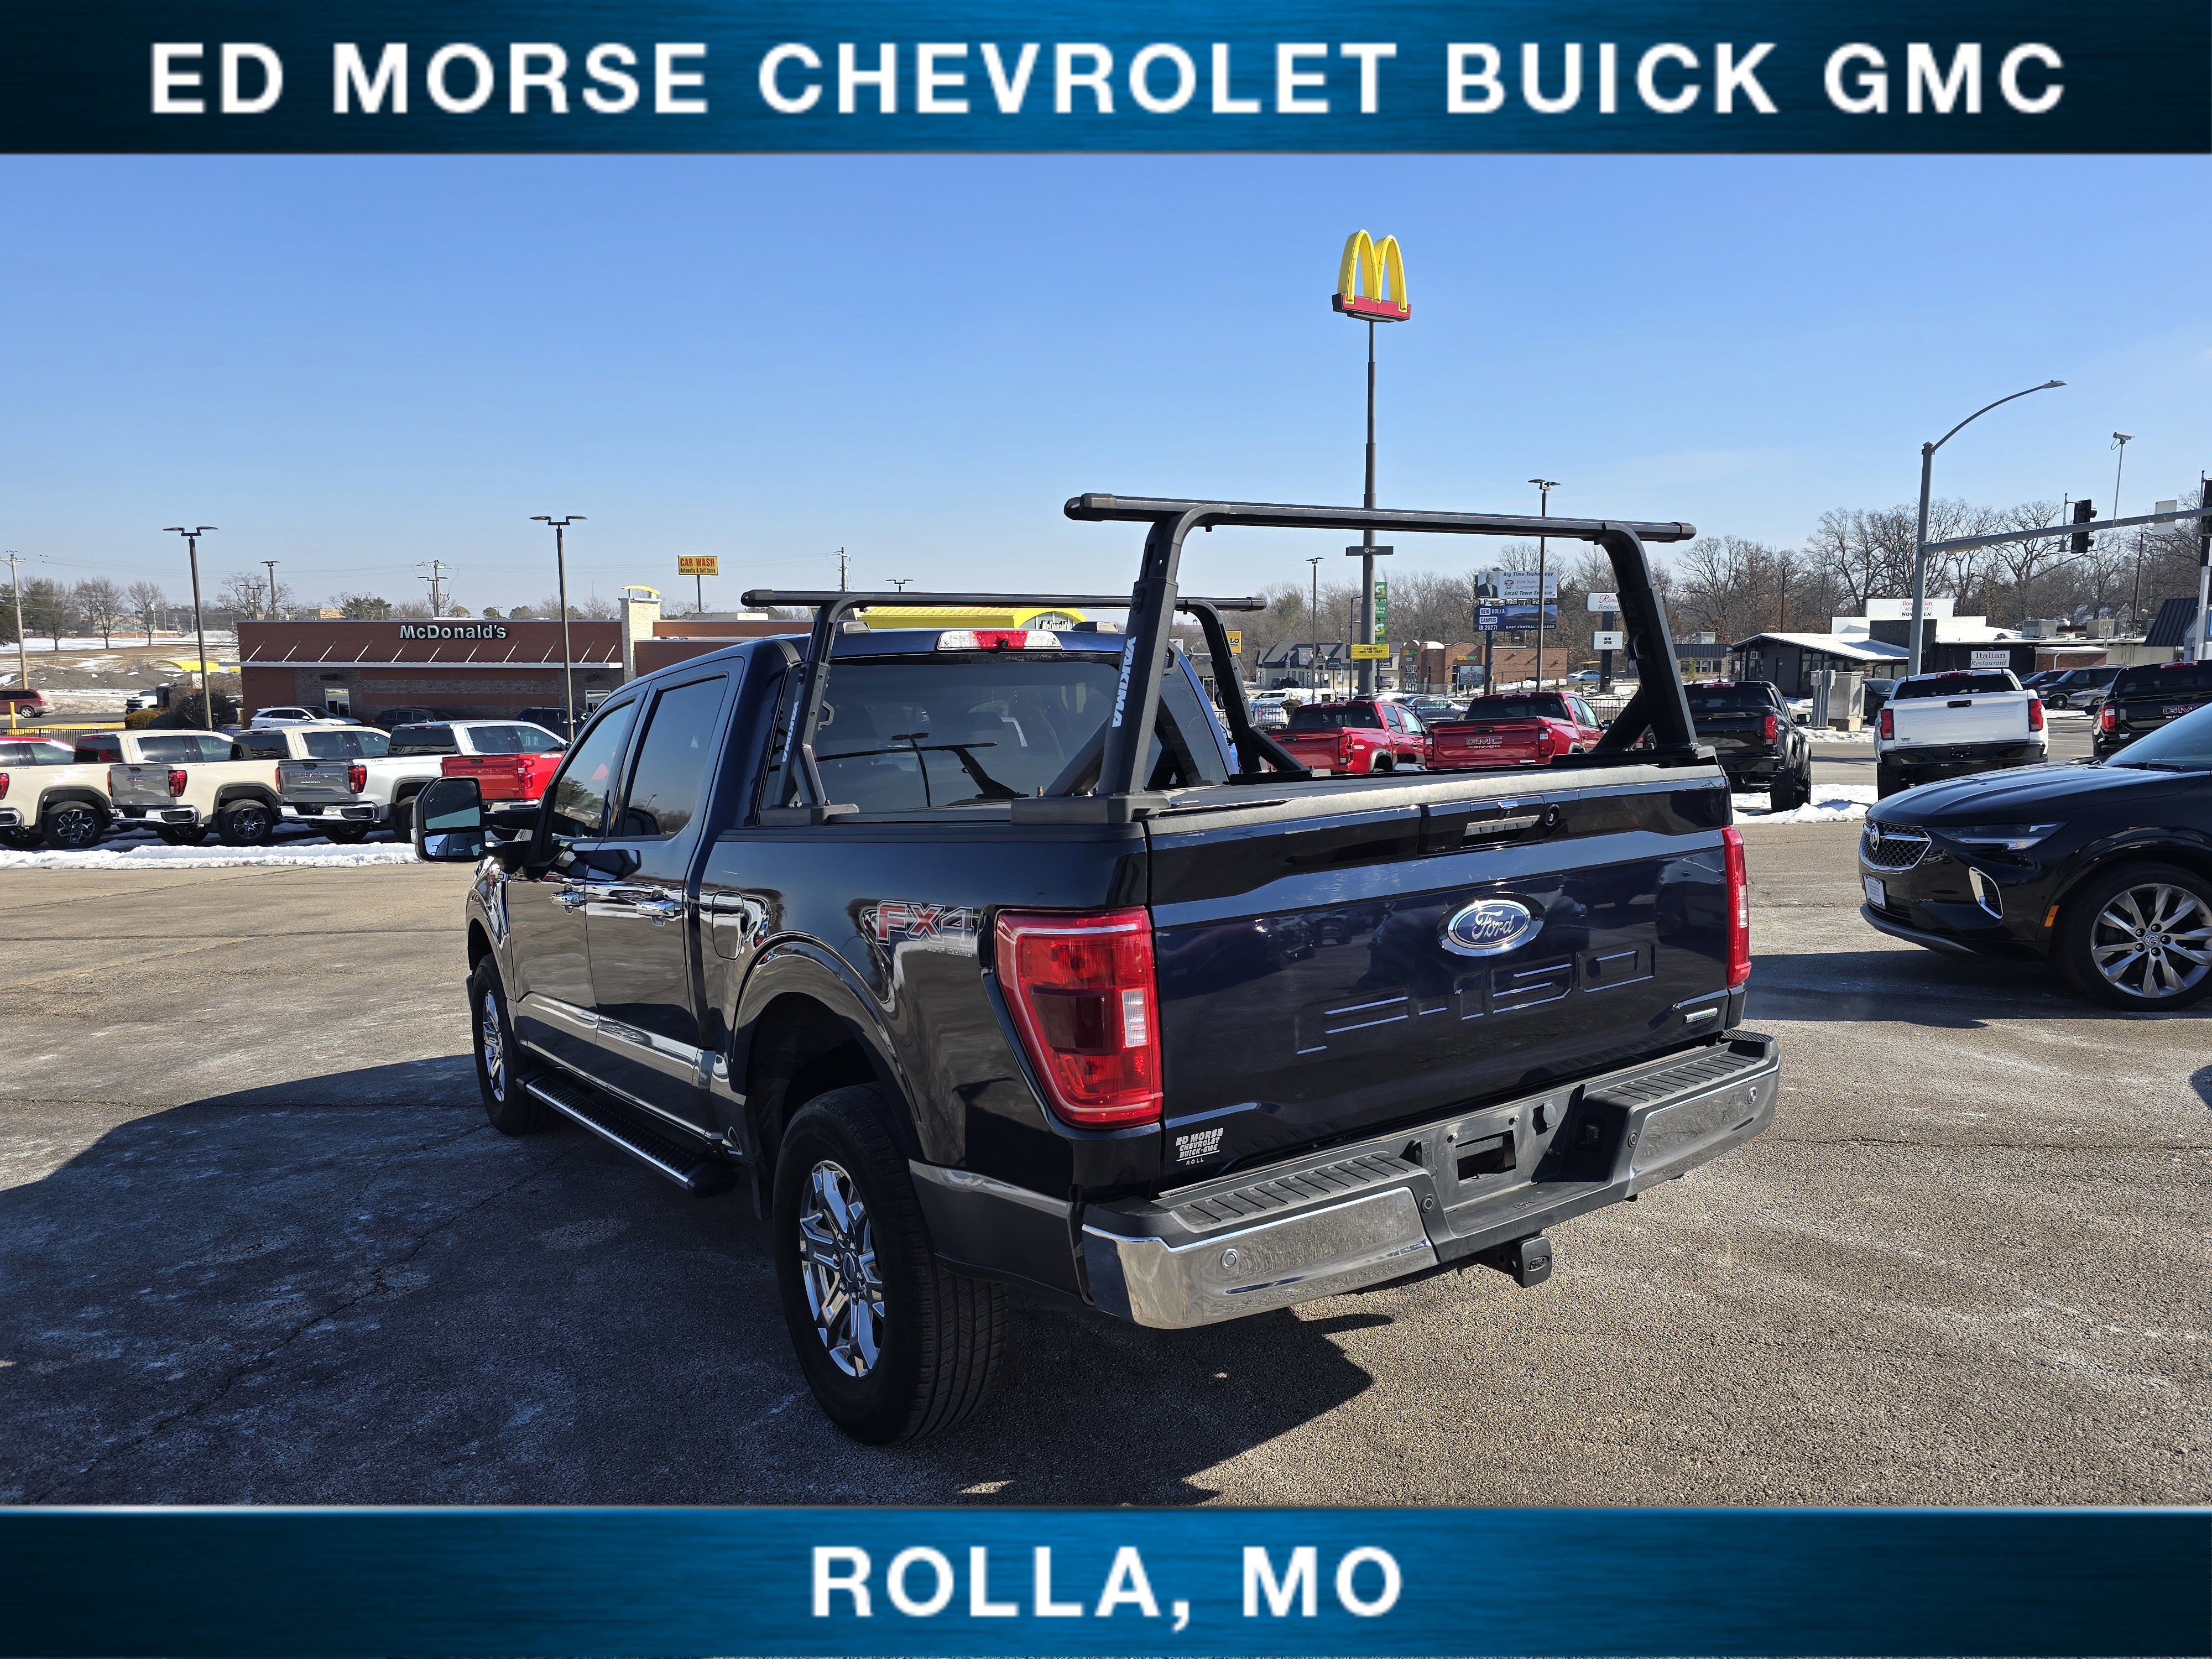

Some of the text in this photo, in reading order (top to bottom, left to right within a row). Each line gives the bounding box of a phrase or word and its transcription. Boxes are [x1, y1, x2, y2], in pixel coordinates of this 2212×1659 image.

[680, 557, 714, 567] CAR WASH
[399, 624, 507, 639] McDonald's
[1112, 636, 1137, 728] YAKIMA
[781, 701, 800, 763] YAKIMA
[1467, 736, 1503, 745] GMC
[875, 899, 975, 947] FX4
[1472, 910, 1515, 940] Ford
[927, 943, 972, 957] OFF ROAD
[1175, 1127, 1224, 1146] ED MORSE
[1179, 1136, 1220, 1152] CHEVROLET
